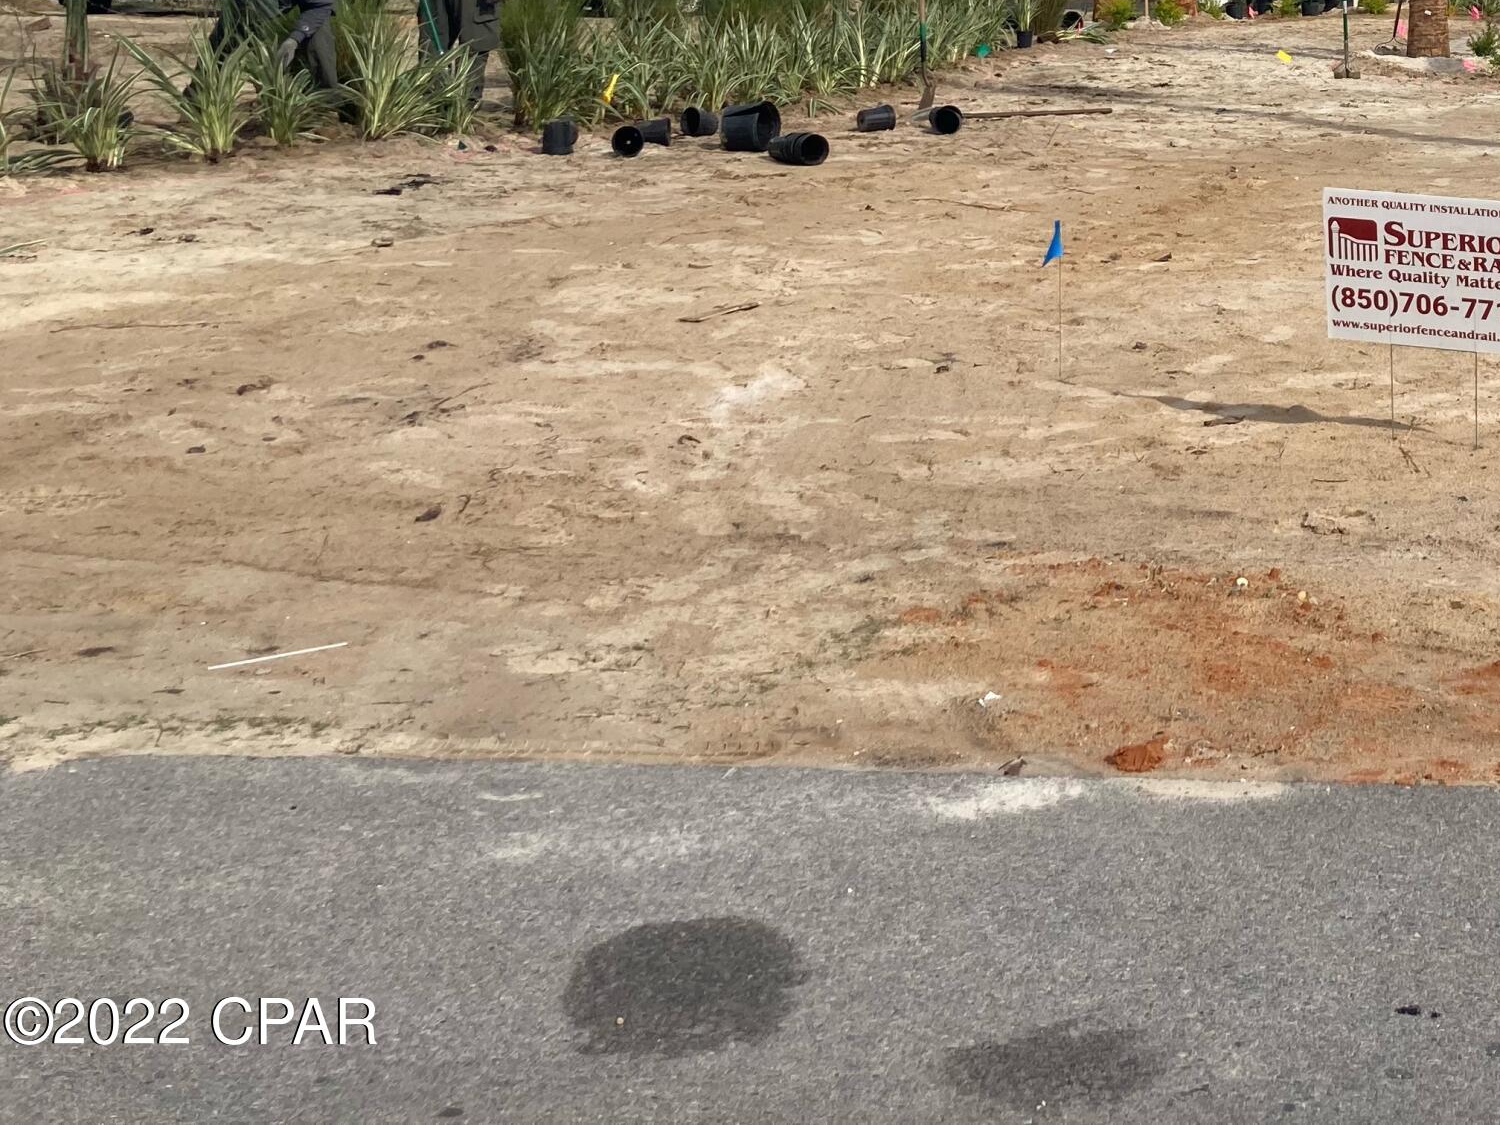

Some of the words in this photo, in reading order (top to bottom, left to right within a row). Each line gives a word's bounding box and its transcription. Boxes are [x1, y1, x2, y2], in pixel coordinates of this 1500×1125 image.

[1327, 196, 1378, 208] ANOTHER
[1381, 200, 1427, 212] QUALITY
[1330, 263, 1383, 280] Where
[1388, 268, 1450, 288] Quality
